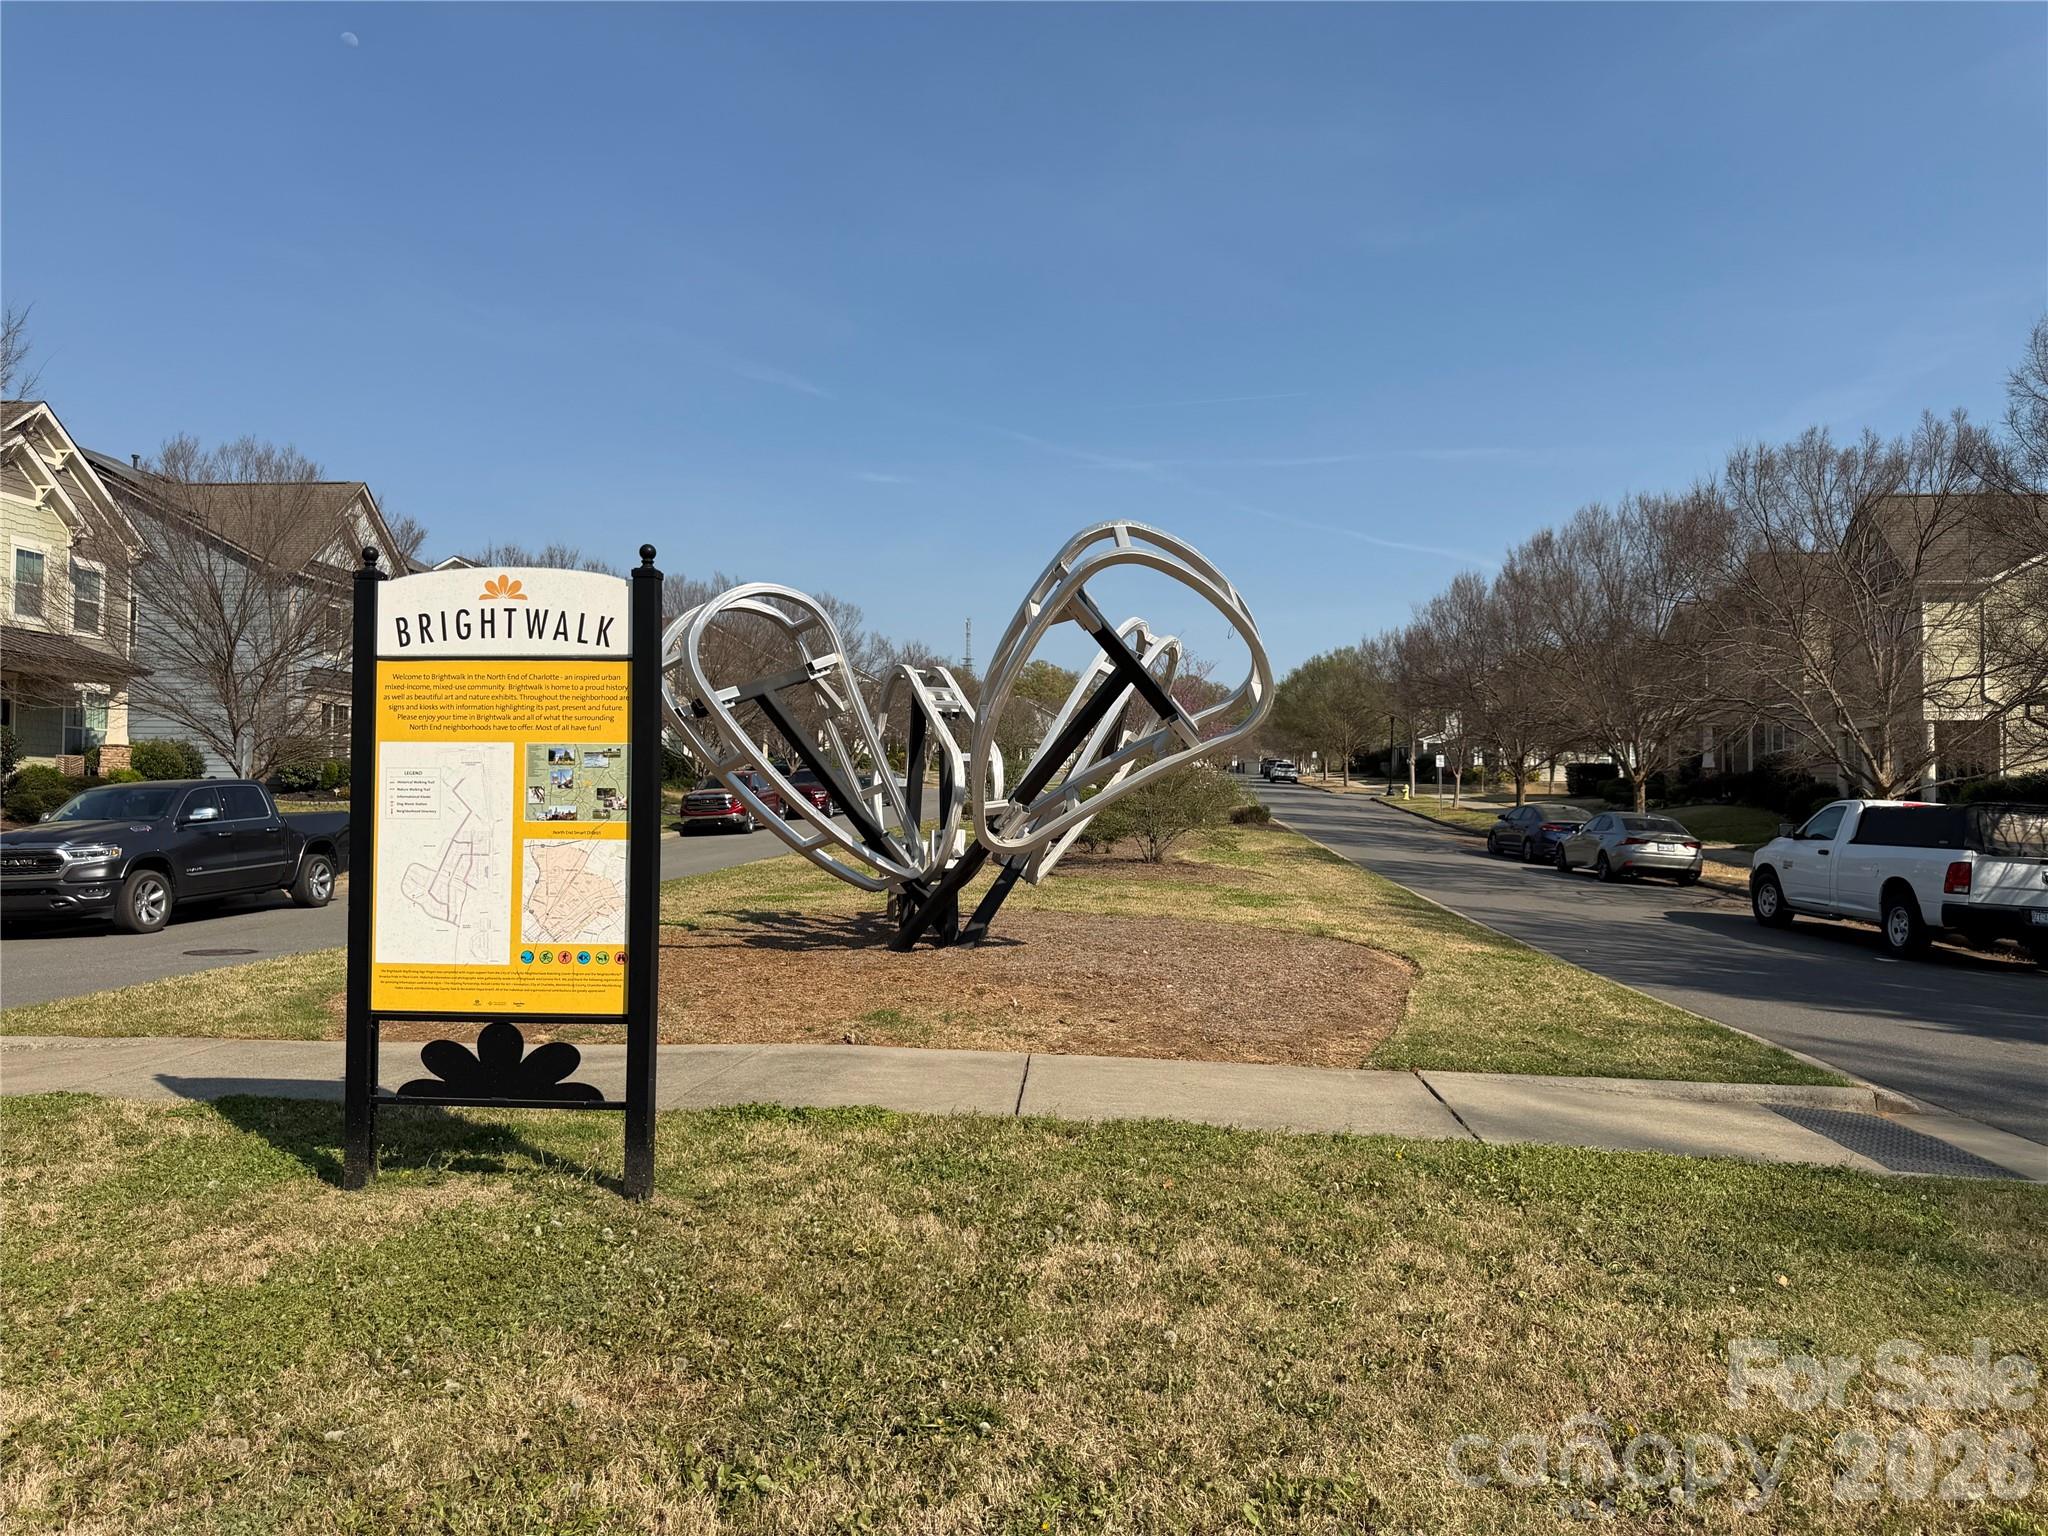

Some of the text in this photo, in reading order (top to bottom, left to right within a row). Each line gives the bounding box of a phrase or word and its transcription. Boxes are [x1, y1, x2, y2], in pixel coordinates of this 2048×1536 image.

[396, 608, 615, 648] BRIGHTWALK
[574, 674, 600, 682] inspired
[508, 684, 543, 692] Brightwalk
[585, 684, 605, 692] proud
[606, 684, 630, 692] history
[519, 694, 559, 702] Throughout
[571, 694, 618, 702] neighborhood
[388, 704, 405, 712] signs
[495, 704, 535, 712] highlighting
[561, 704, 586, 712] present
[418, 714, 436, 722] enjoy
[476, 714, 511, 722] Brightwalk
[574, 714, 615, 723] surrounding
[443, 724, 492, 732] neighborhoods
